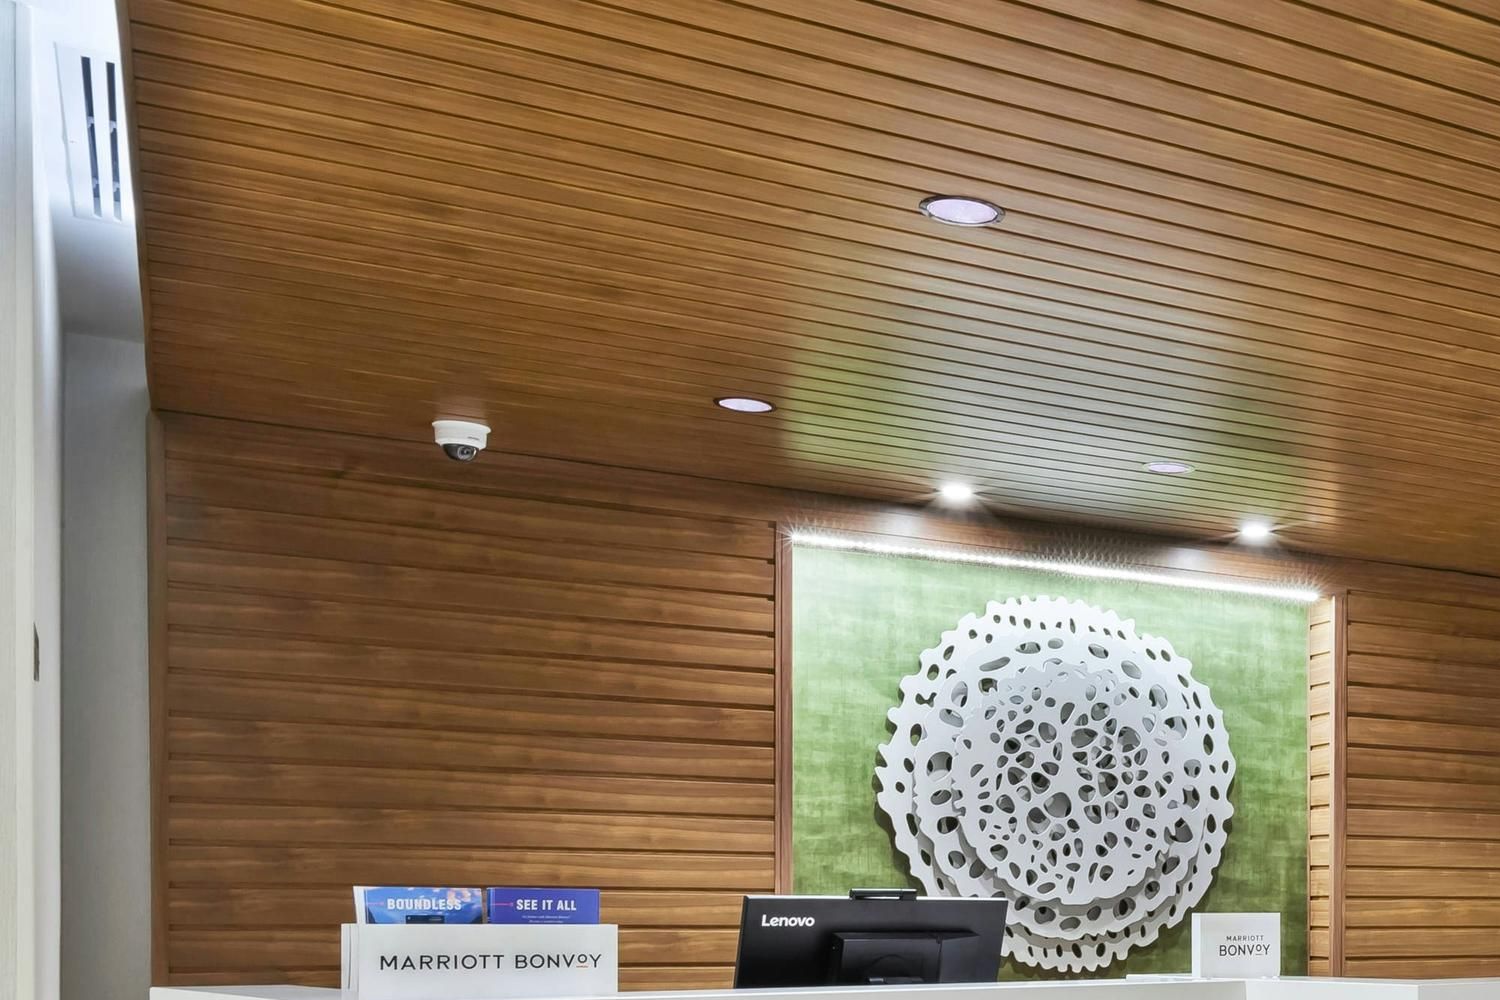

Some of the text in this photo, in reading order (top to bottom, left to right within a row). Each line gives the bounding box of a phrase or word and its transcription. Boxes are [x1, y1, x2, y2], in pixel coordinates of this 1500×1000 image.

[387, 898, 462, 911] BOUNDLESS
[516, 899, 577, 911] SEE IT ALL
[761, 914, 815, 927] Lenovo
[1219, 944, 1270, 956] BONVOY
[380, 953, 602, 970] MARRIOTT BONVOY
